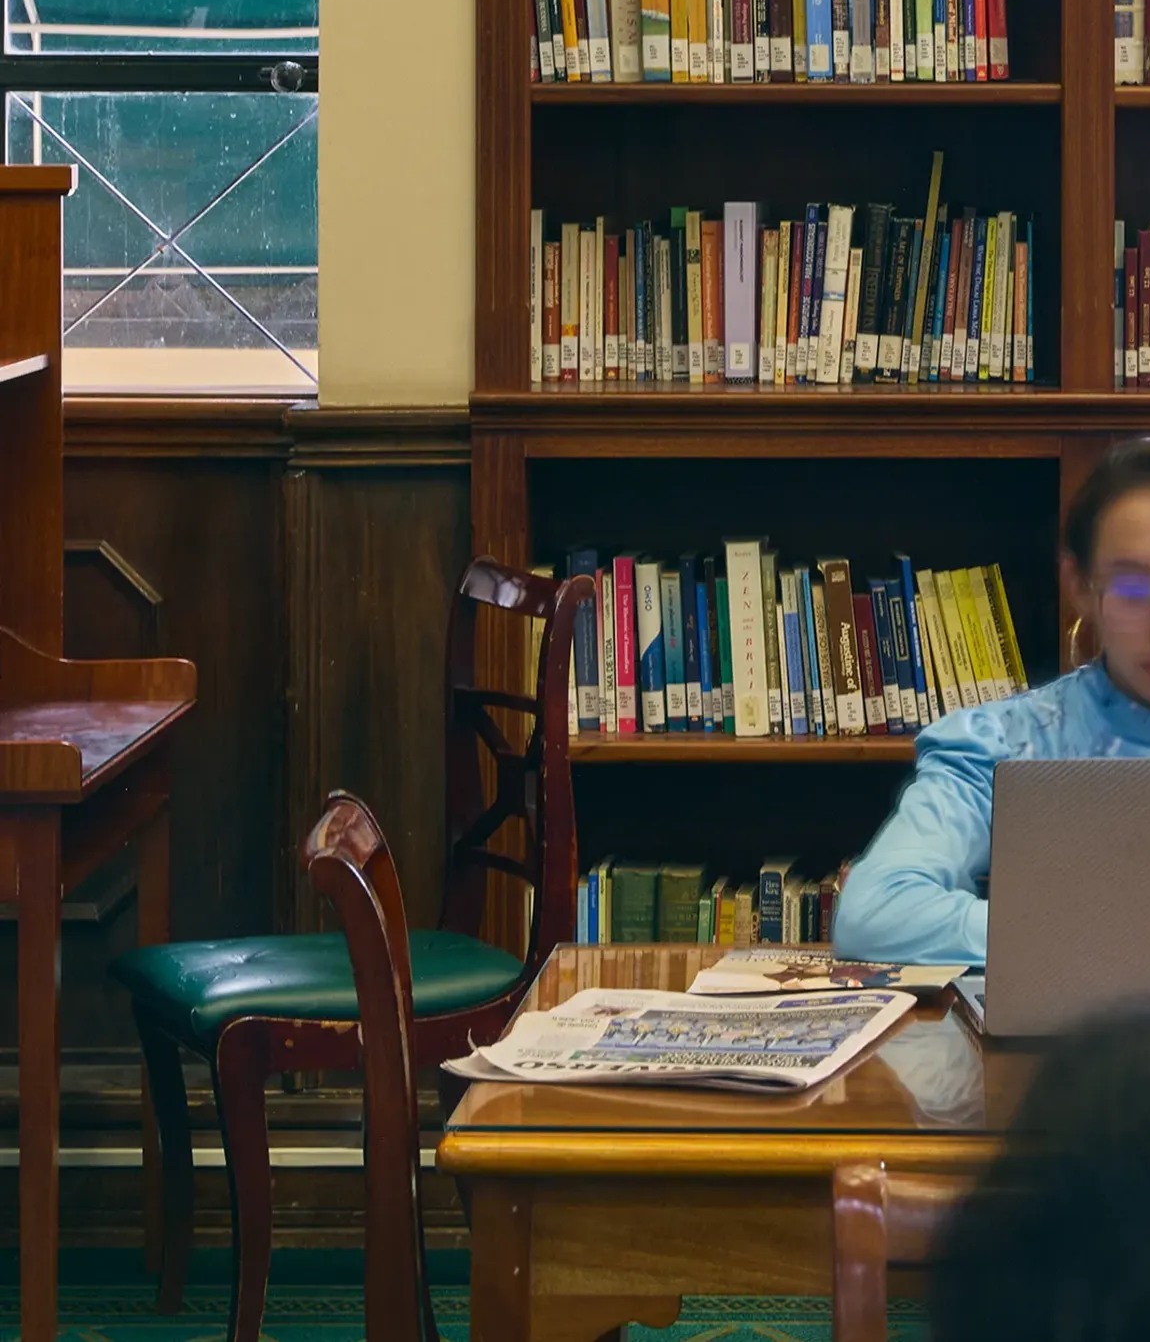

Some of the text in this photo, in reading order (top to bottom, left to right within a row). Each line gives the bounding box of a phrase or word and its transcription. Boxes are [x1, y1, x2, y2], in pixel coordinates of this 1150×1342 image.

[816, 604, 826, 634] PADRES
[820, 635, 828, 652] LOS
[822, 653, 829, 664] DE
[839, 622, 860, 690] Augustine of
[606, 660, 613, 672] DE
